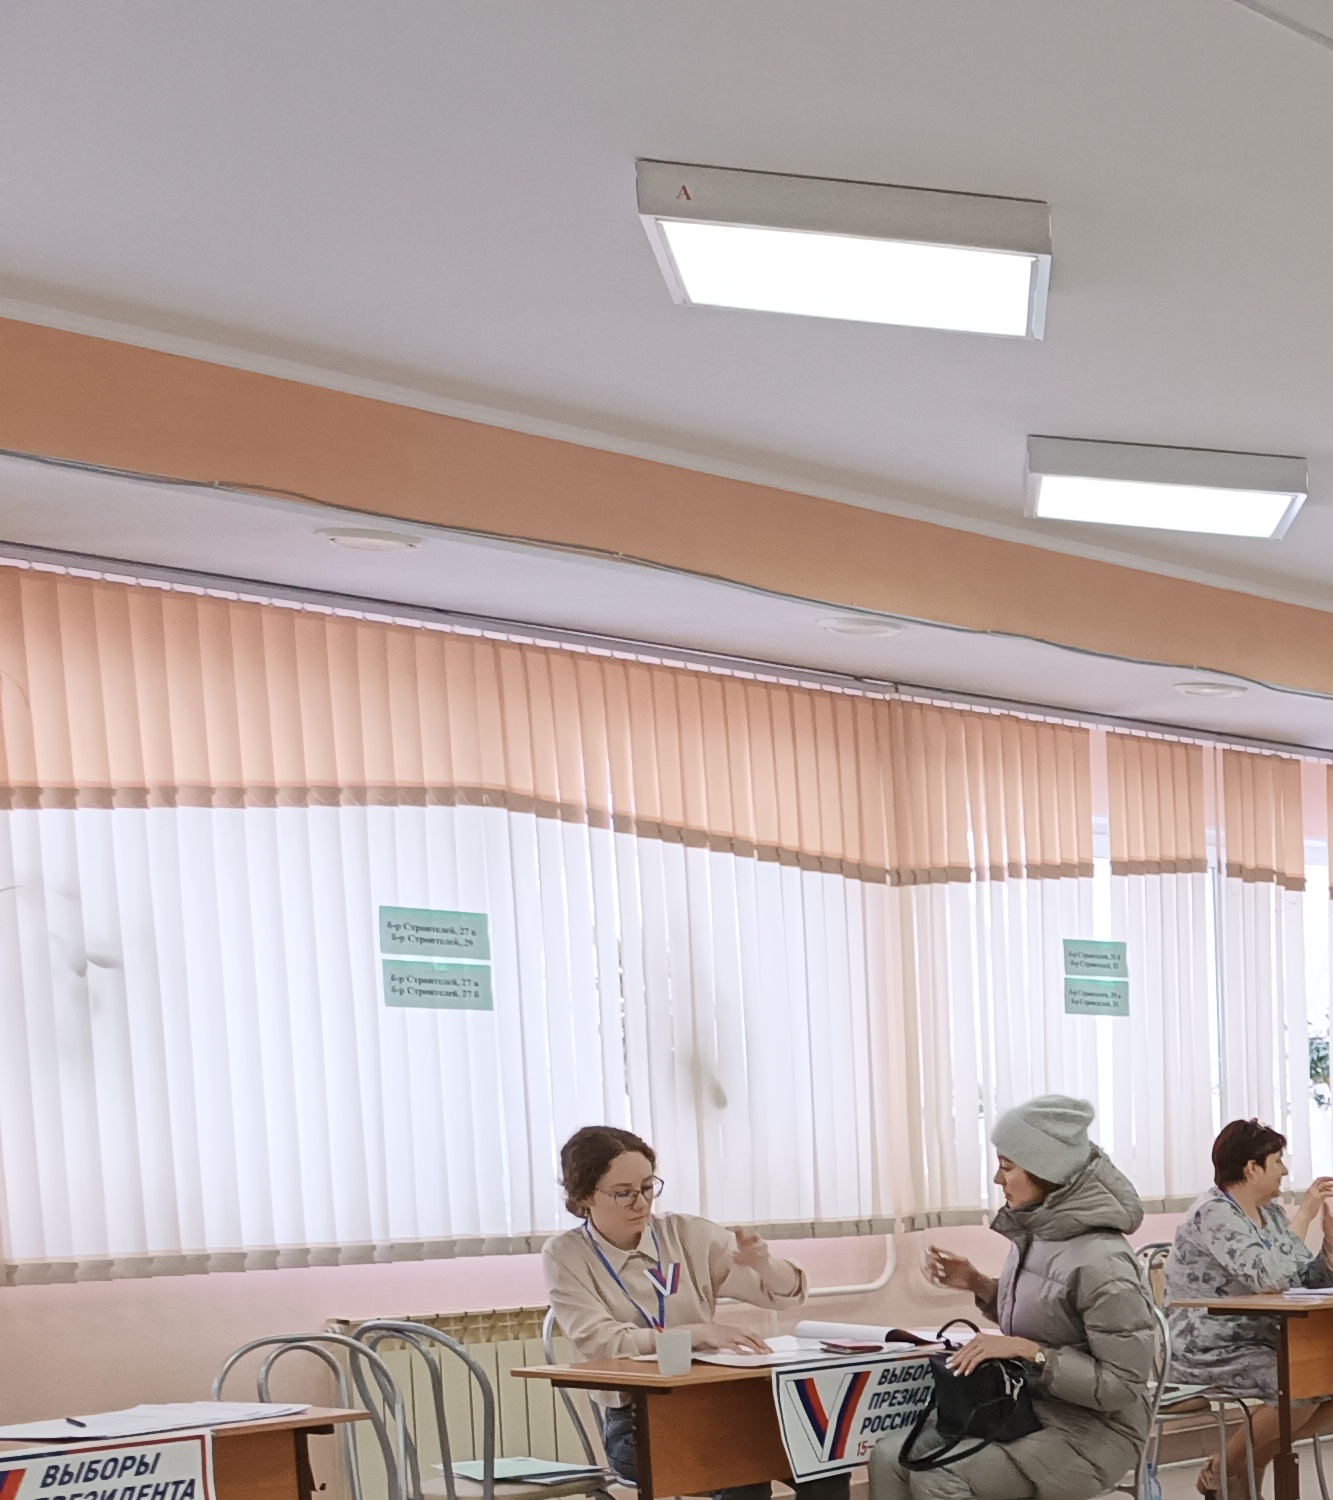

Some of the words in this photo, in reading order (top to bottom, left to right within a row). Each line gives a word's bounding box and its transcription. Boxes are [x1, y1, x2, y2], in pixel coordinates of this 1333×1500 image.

[877, 1364, 936, 1386] ВЫБОР
[868, 1386, 932, 1411] ПРЕЗИД
[40, 1452, 162, 1488] ВЫБОРЫ
